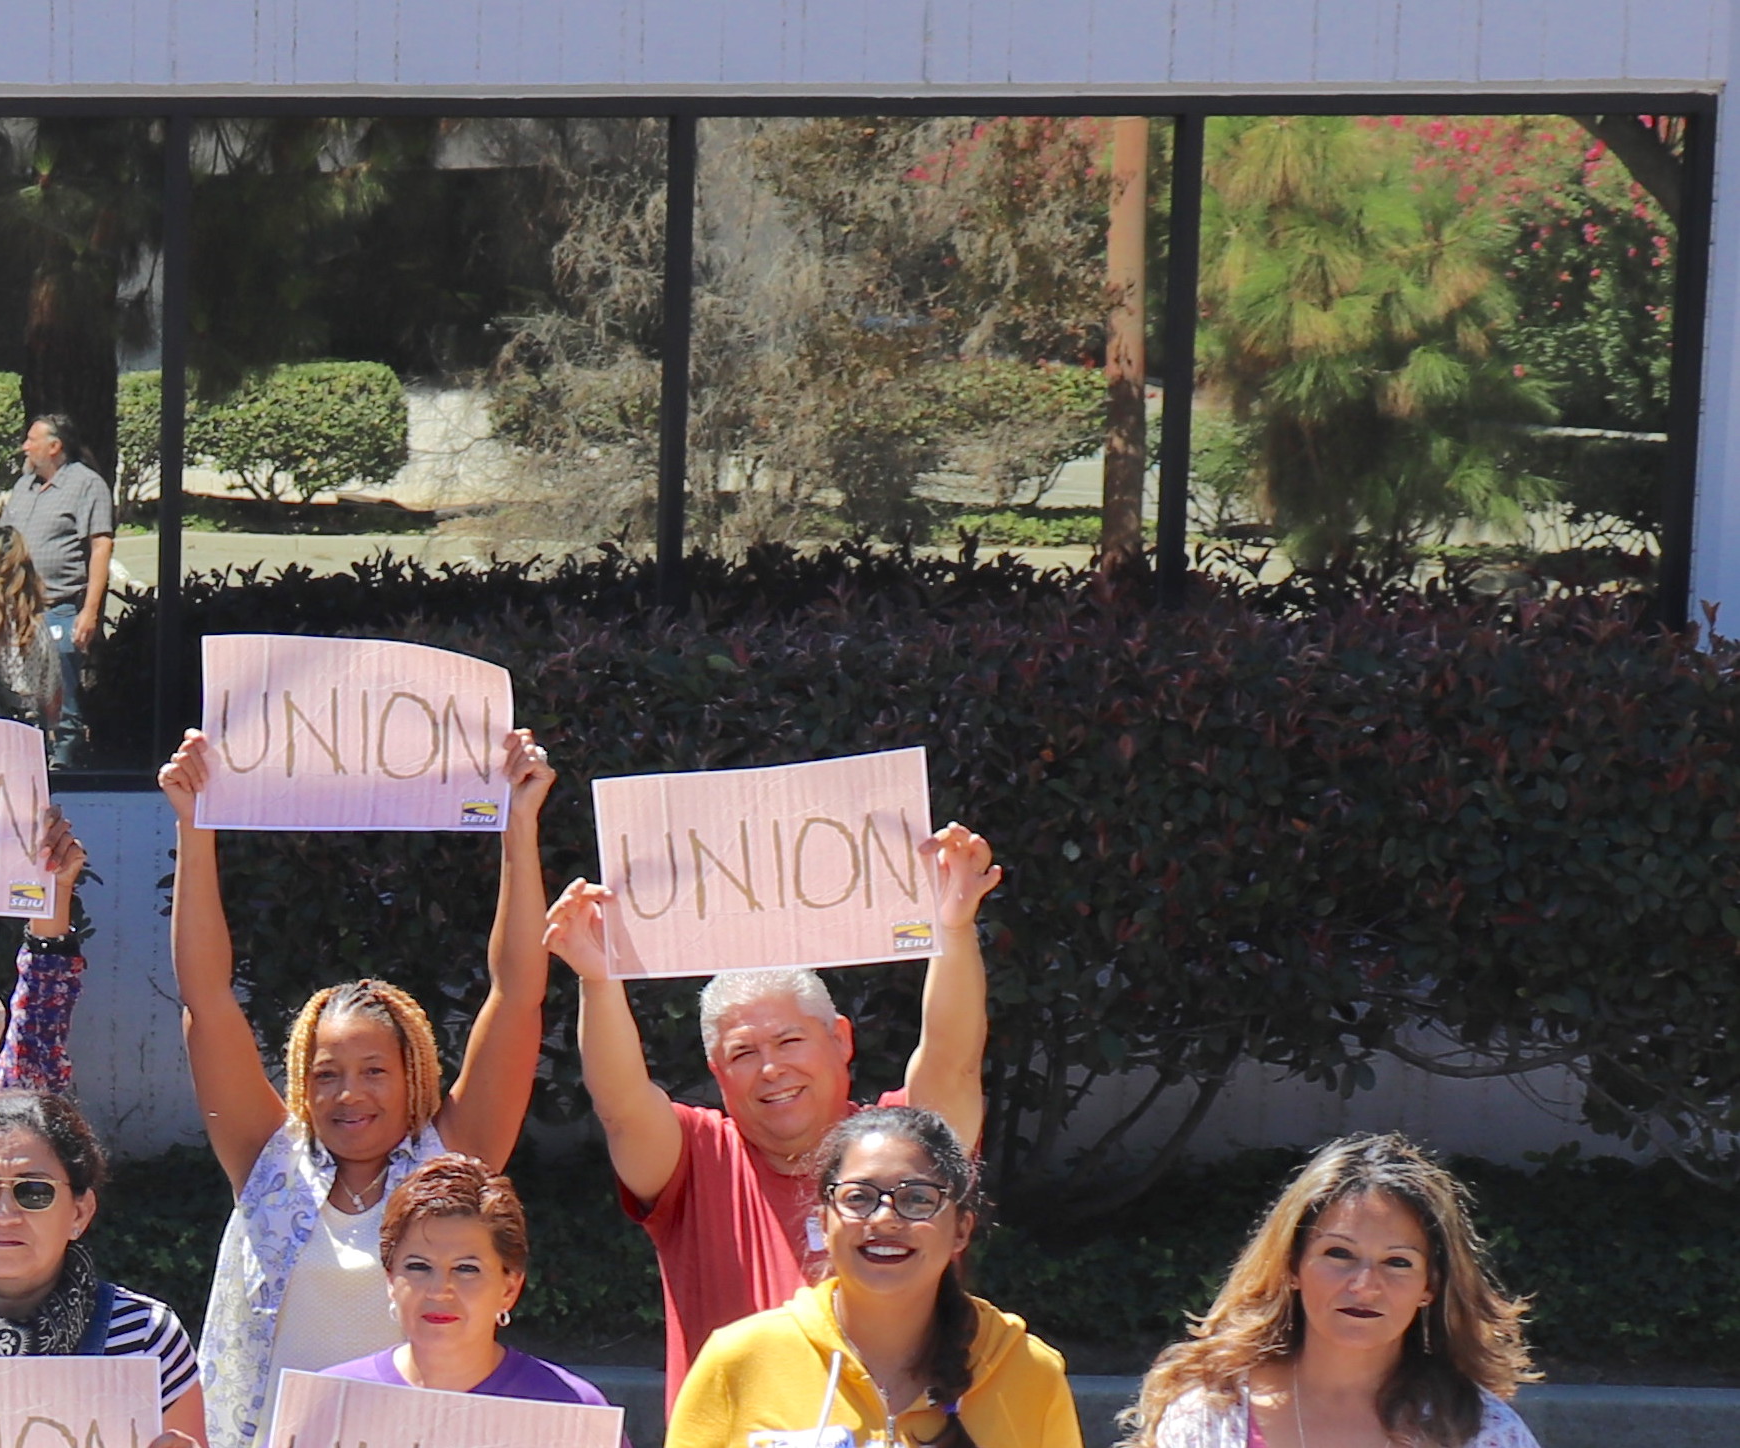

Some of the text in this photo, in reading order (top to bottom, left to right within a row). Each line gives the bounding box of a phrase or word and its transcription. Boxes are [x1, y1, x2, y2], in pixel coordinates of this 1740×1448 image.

[221, 686, 490, 784] UNION
[621, 808, 919, 920] UNION
[11, 898, 43, 906] SEIU
[895, 938, 930, 948] SEIU
